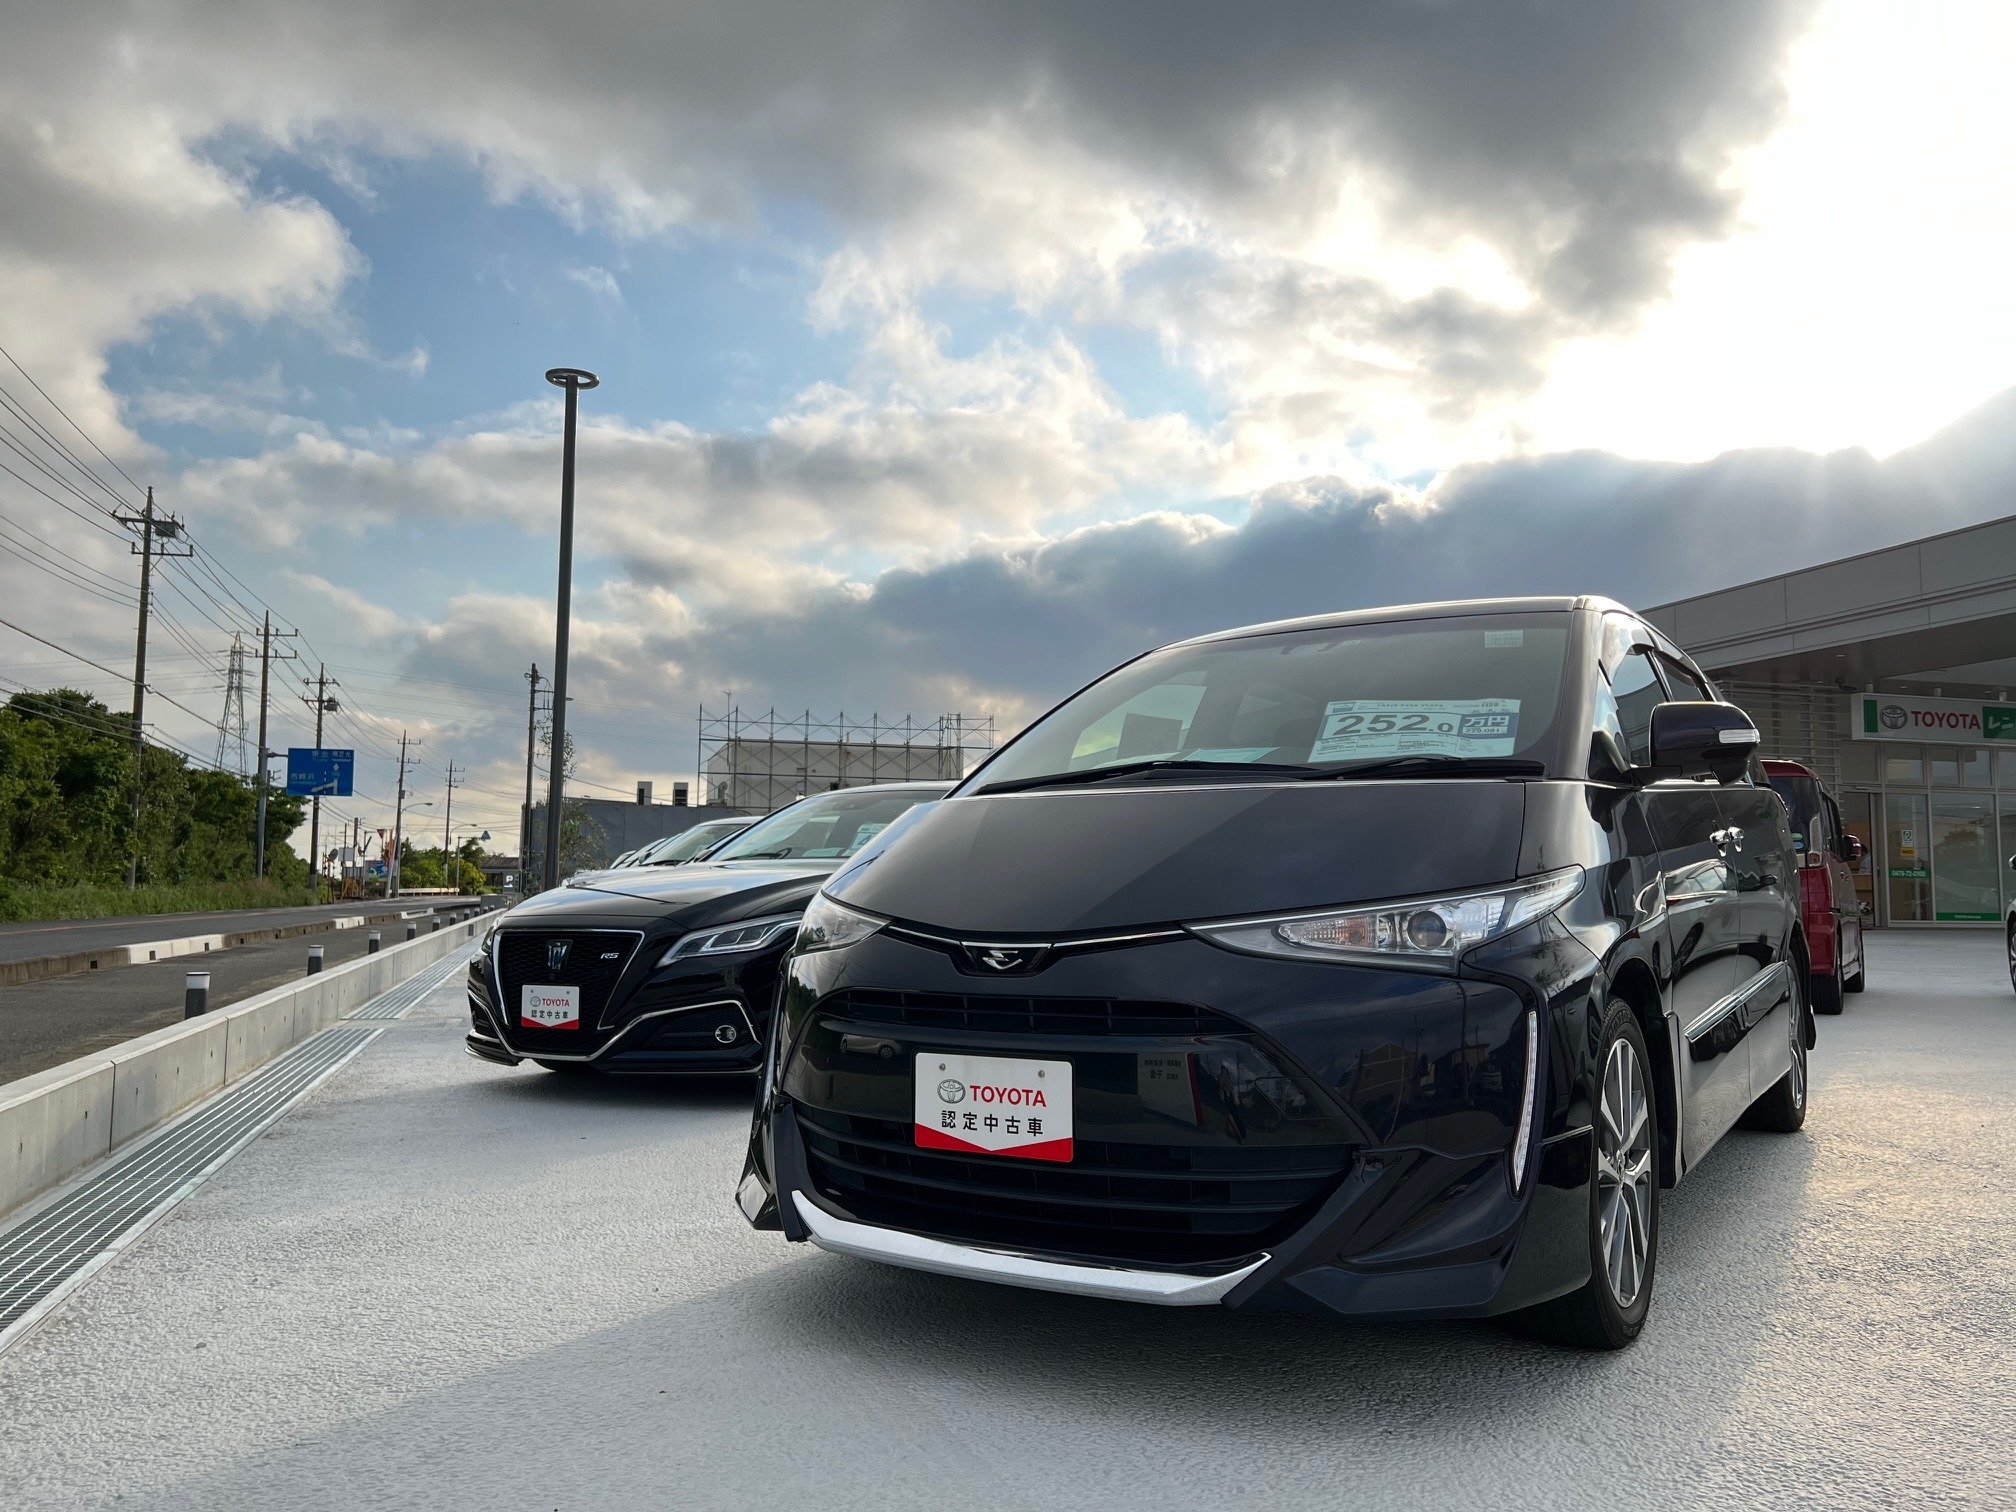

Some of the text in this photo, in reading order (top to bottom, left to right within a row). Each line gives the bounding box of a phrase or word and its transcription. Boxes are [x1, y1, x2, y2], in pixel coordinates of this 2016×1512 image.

[1333, 714, 1454, 736] 252.0
[1464, 715, 1510, 727] 万円
[1911, 710, 1981, 730] TOYOTA
[506, 875, 514, 883] P
[542, 998, 570, 1007] TOYOTA
[531, 1009, 569, 1019] 認定中古車
[969, 1085, 1047, 1108] TOYOTA
[941, 1110, 1043, 1137] 認定中古車
